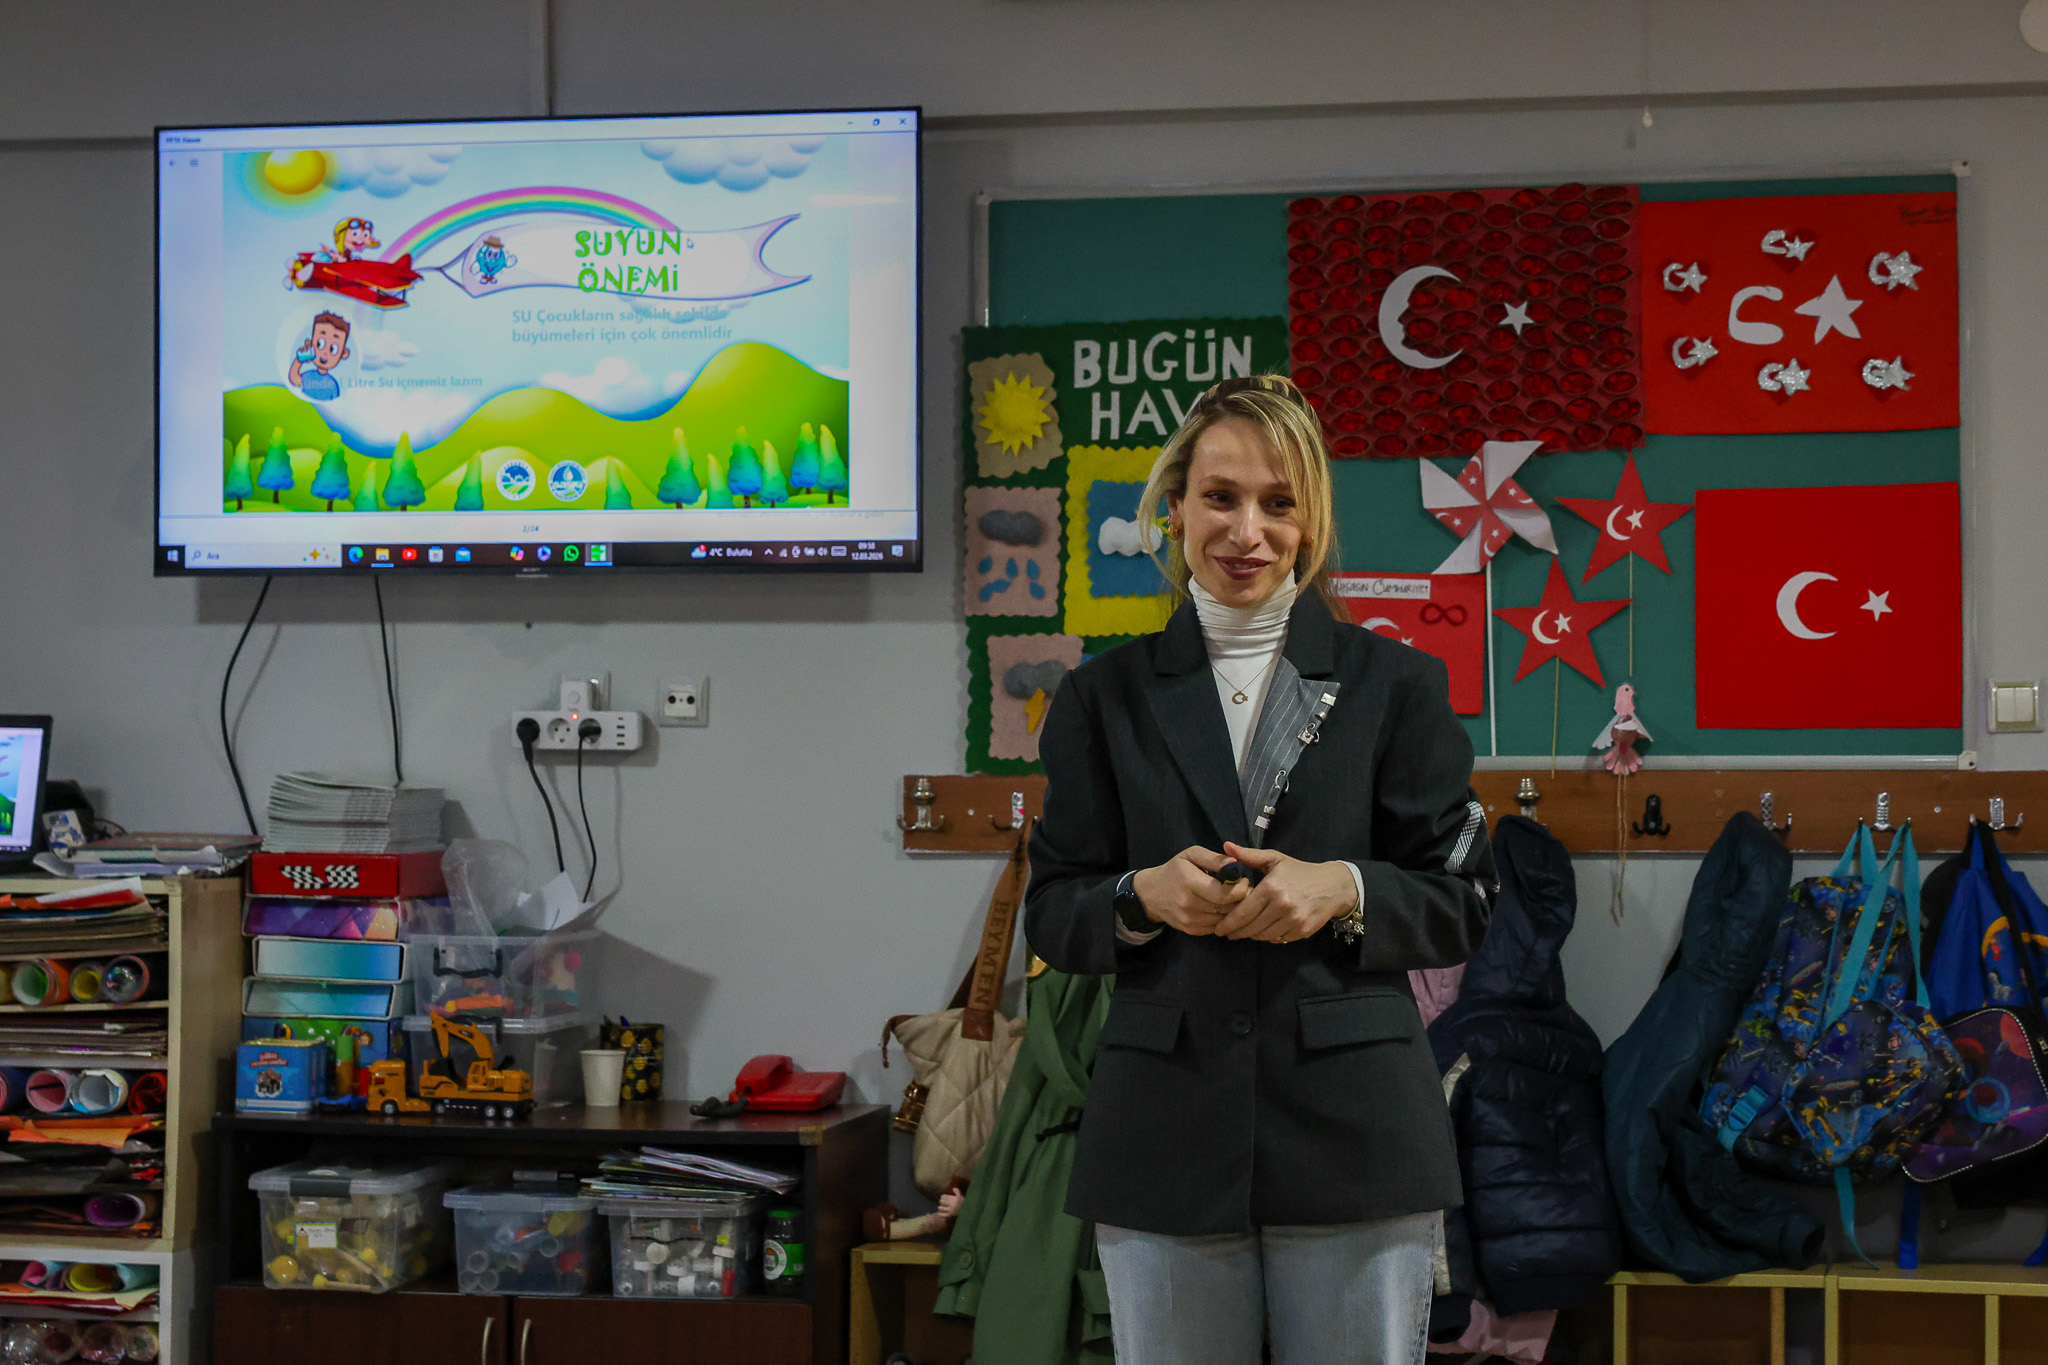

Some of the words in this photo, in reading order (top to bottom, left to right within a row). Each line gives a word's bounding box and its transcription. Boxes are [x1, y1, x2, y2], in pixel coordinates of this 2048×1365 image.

[575, 227, 681, 258] SUYUN
[512, 310, 532, 323] SU
[537, 309, 614, 325] Çocukların
[512, 328, 595, 345] büyümeleri
[601, 328, 625, 344] için
[631, 328, 656, 344] çok
[663, 326, 732, 341] önemlidir
[1073, 328, 1252, 389] BUGÜN
[348, 377, 375, 388] Litre
[379, 376, 393, 387] Su
[397, 376, 446, 389] içmemiz
[450, 375, 482, 387] lazım
[1090, 388, 1205, 441] HAV
[974, 900, 1011, 1005] BEYMEN
